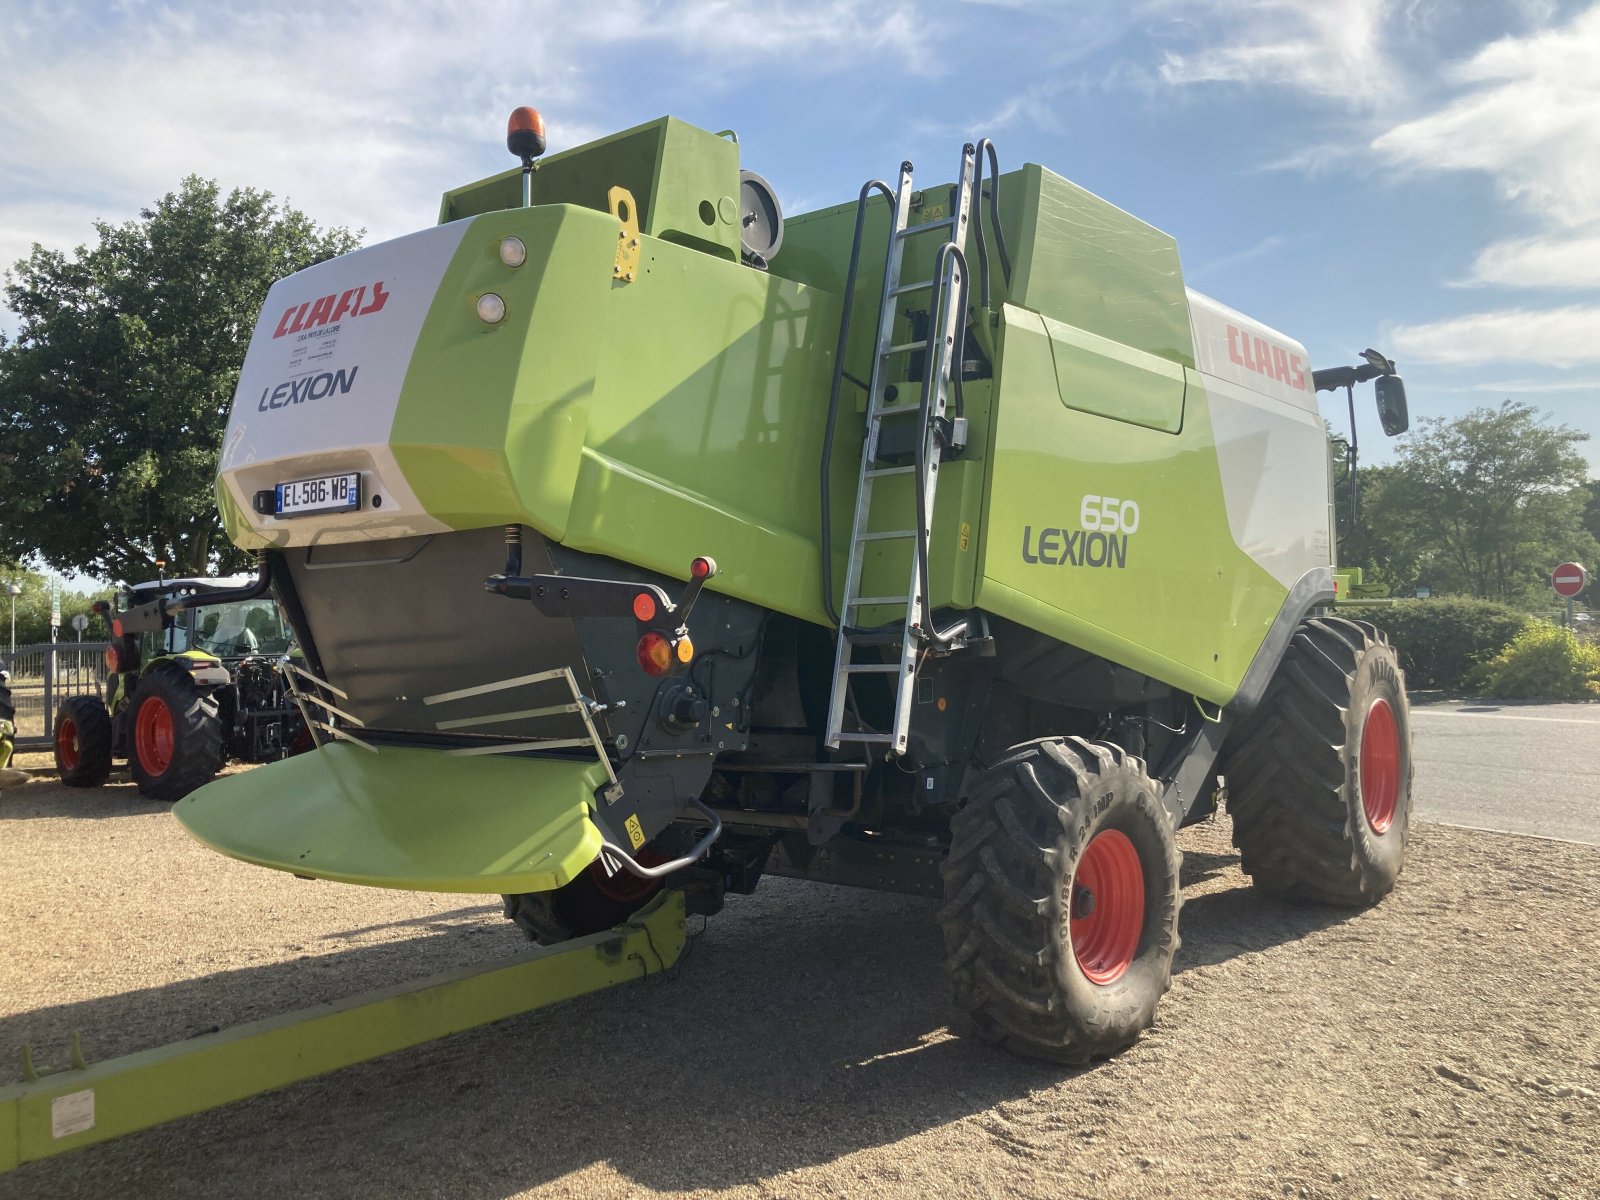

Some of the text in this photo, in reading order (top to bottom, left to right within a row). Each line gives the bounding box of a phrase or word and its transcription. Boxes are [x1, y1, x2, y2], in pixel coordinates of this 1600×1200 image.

[272, 281, 389, 339] CLAAS
[1226, 324, 1306, 392] CLAAS
[258, 365, 360, 413] LEXION
[283, 477, 348, 507] EL-586-WB
[1080, 494, 1140, 534] 650
[1022, 525, 1128, 569] LEXION
